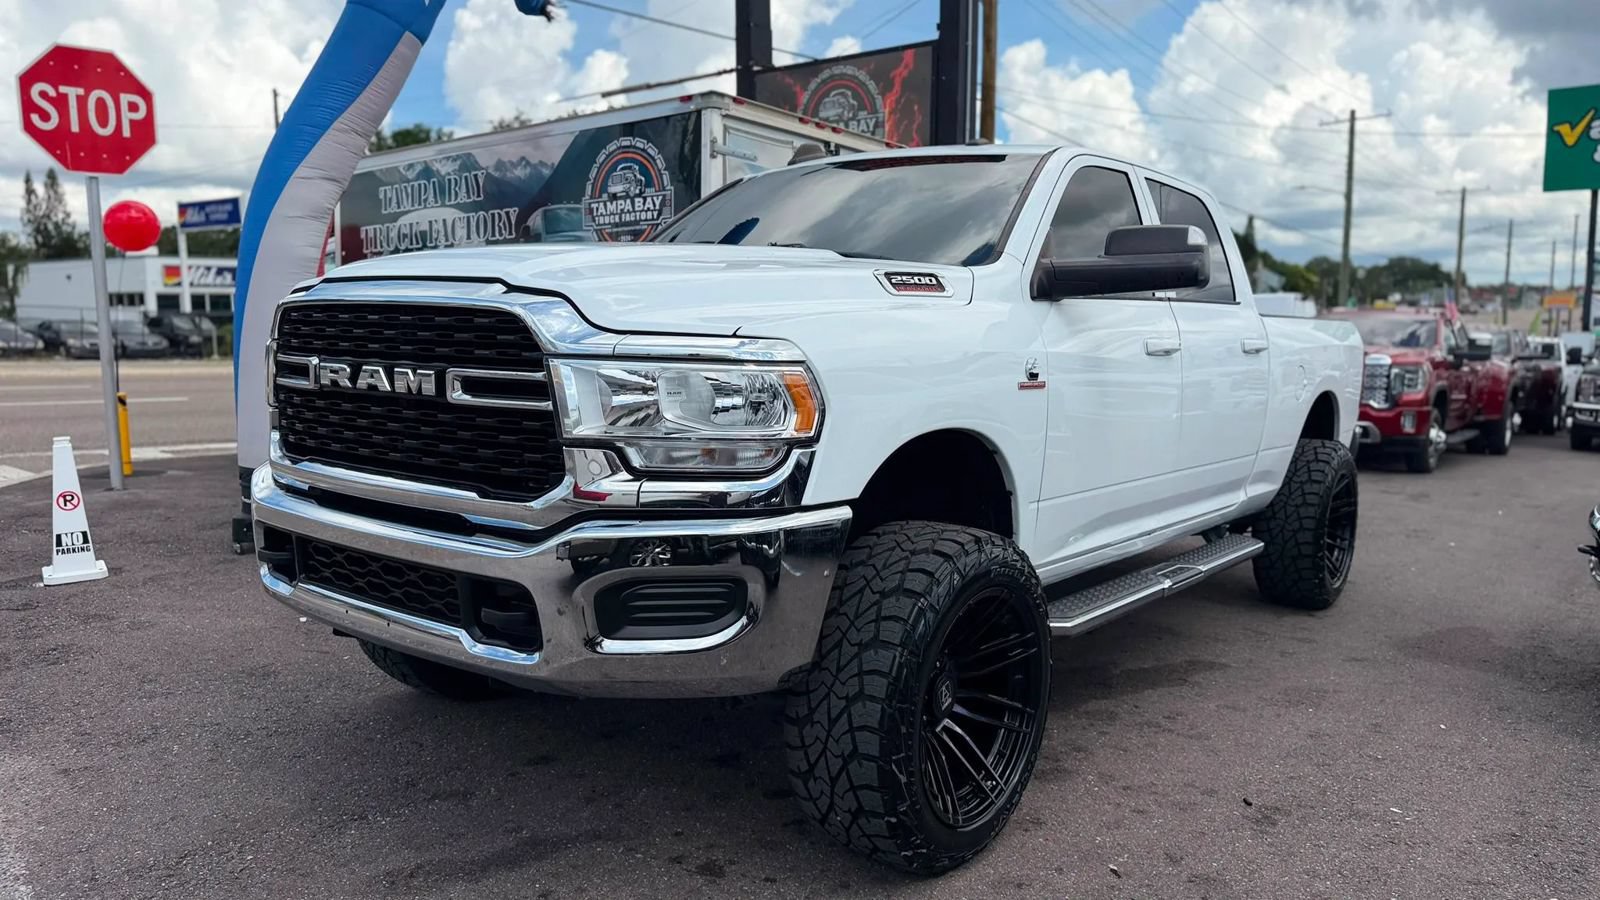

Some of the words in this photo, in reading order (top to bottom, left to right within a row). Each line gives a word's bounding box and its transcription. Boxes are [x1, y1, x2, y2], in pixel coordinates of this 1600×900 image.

[30, 82, 147, 138] STOP
[379, 179, 440, 214] TAMPA
[446, 170, 487, 205] BAY
[591, 199, 633, 216] TAMPA
[634, 196, 662, 211] BAY
[595, 215, 620, 225] TRUCK
[622, 211, 659, 222] FACTORY
[360, 224, 422, 254] TRUCK
[427, 207, 519, 247] FACTORY
[889, 275, 937, 285] 2500
[320, 362, 435, 396] RAM
[61, 531, 84, 546] NO
[56, 545, 91, 556] PARKING
